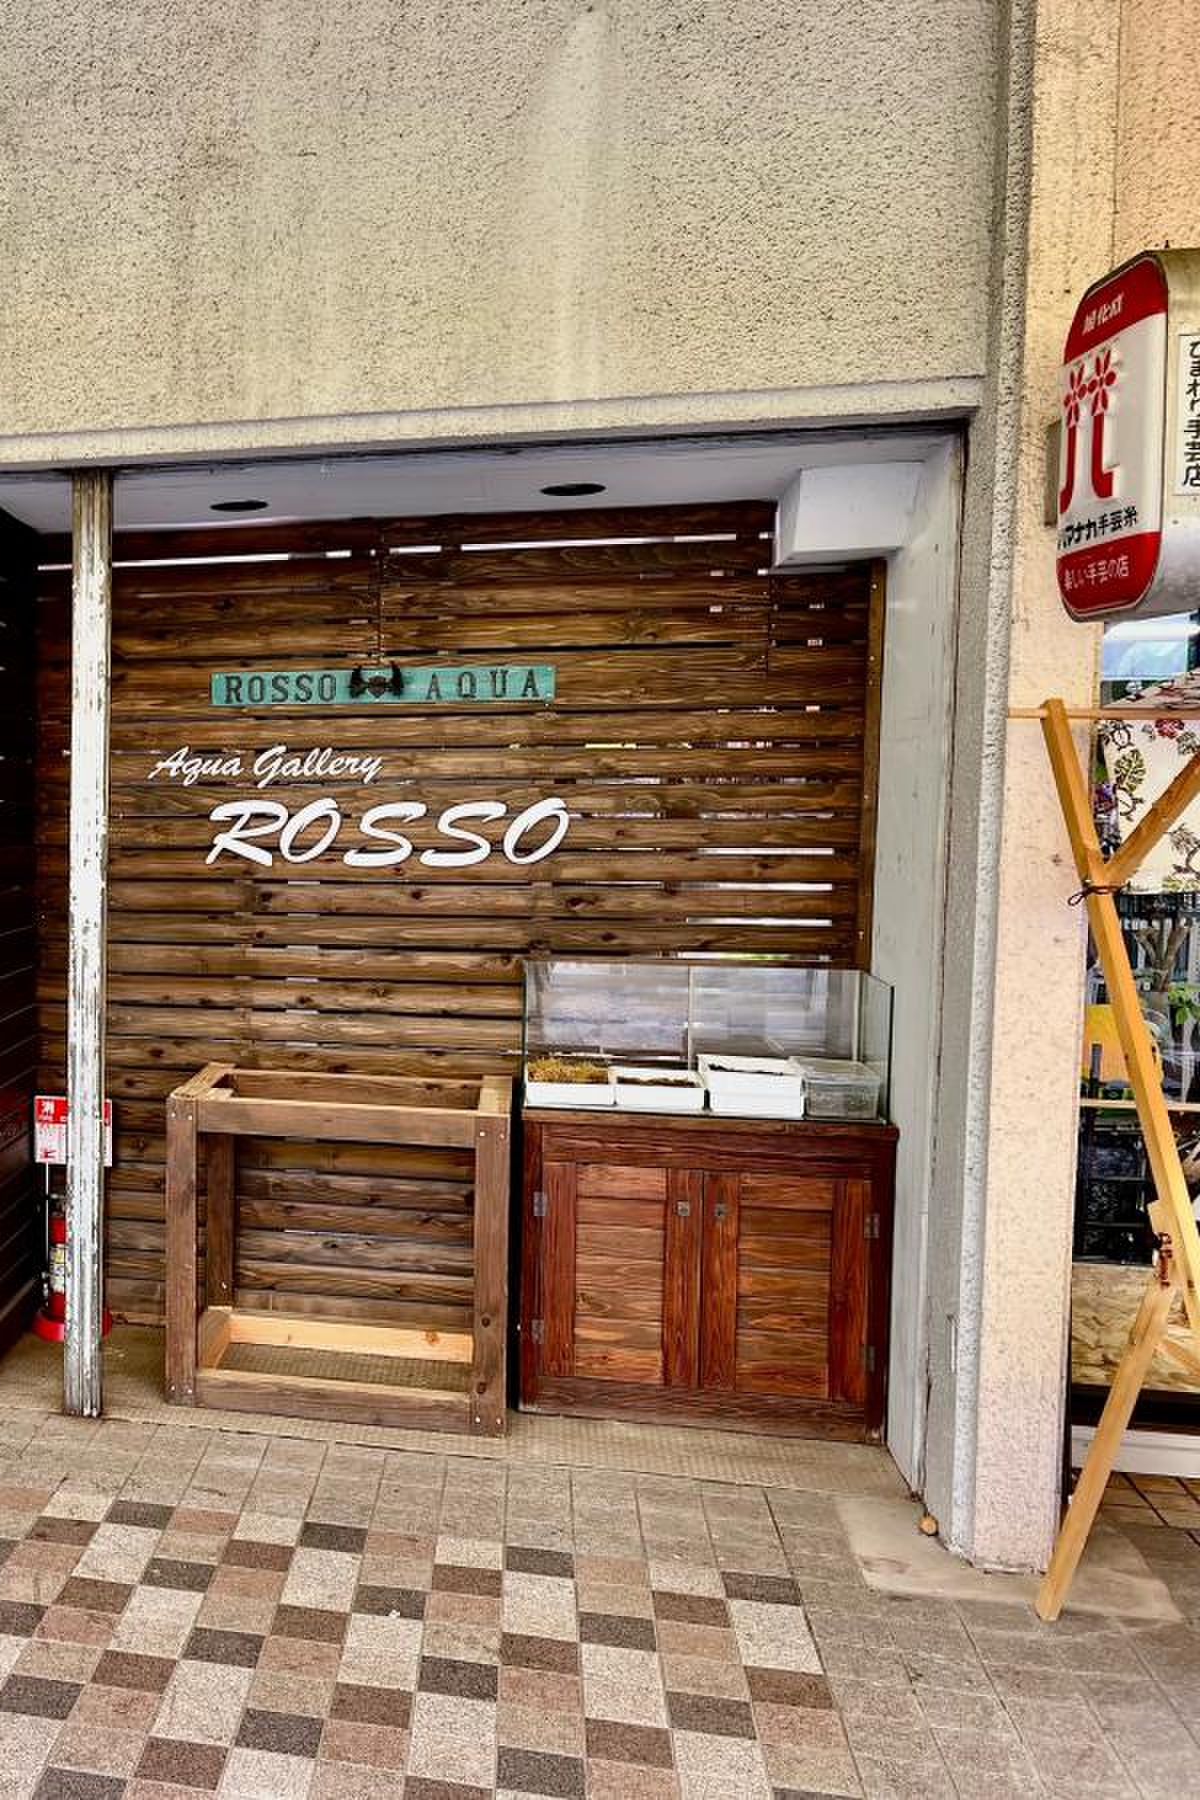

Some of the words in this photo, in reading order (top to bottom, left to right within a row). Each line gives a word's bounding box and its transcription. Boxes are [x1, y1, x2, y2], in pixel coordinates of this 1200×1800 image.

[224, 674, 337, 703] ROSSO
[426, 668, 541, 700] AQUA
[148, 746, 243, 786] Aqua
[253, 745, 383, 788] Gallery
[205, 798, 570, 867] ROSSO
